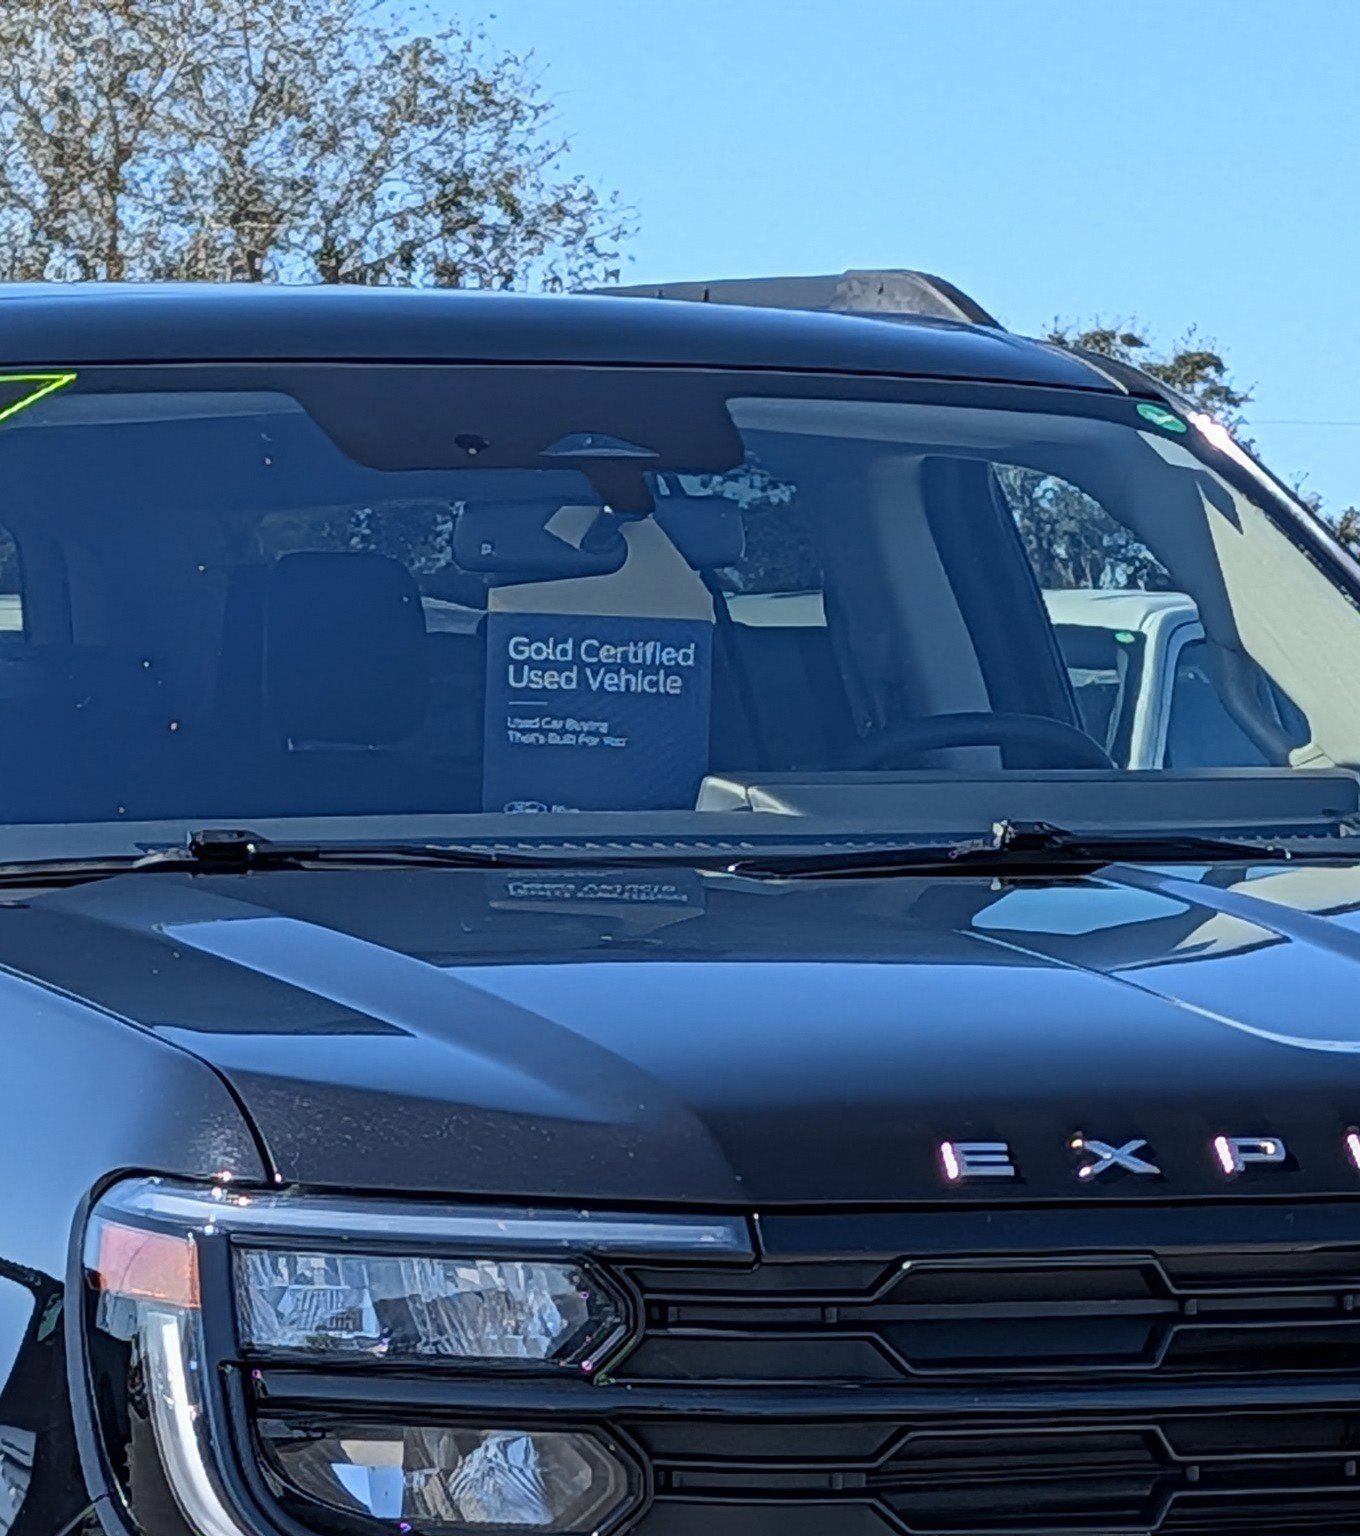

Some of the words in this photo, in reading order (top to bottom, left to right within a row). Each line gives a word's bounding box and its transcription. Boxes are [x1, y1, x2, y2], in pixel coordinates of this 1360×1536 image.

[507, 636, 573, 662] Gold
[580, 638, 695, 667] Certified
[507, 664, 578, 690] Used
[585, 667, 683, 695] Vehicle
